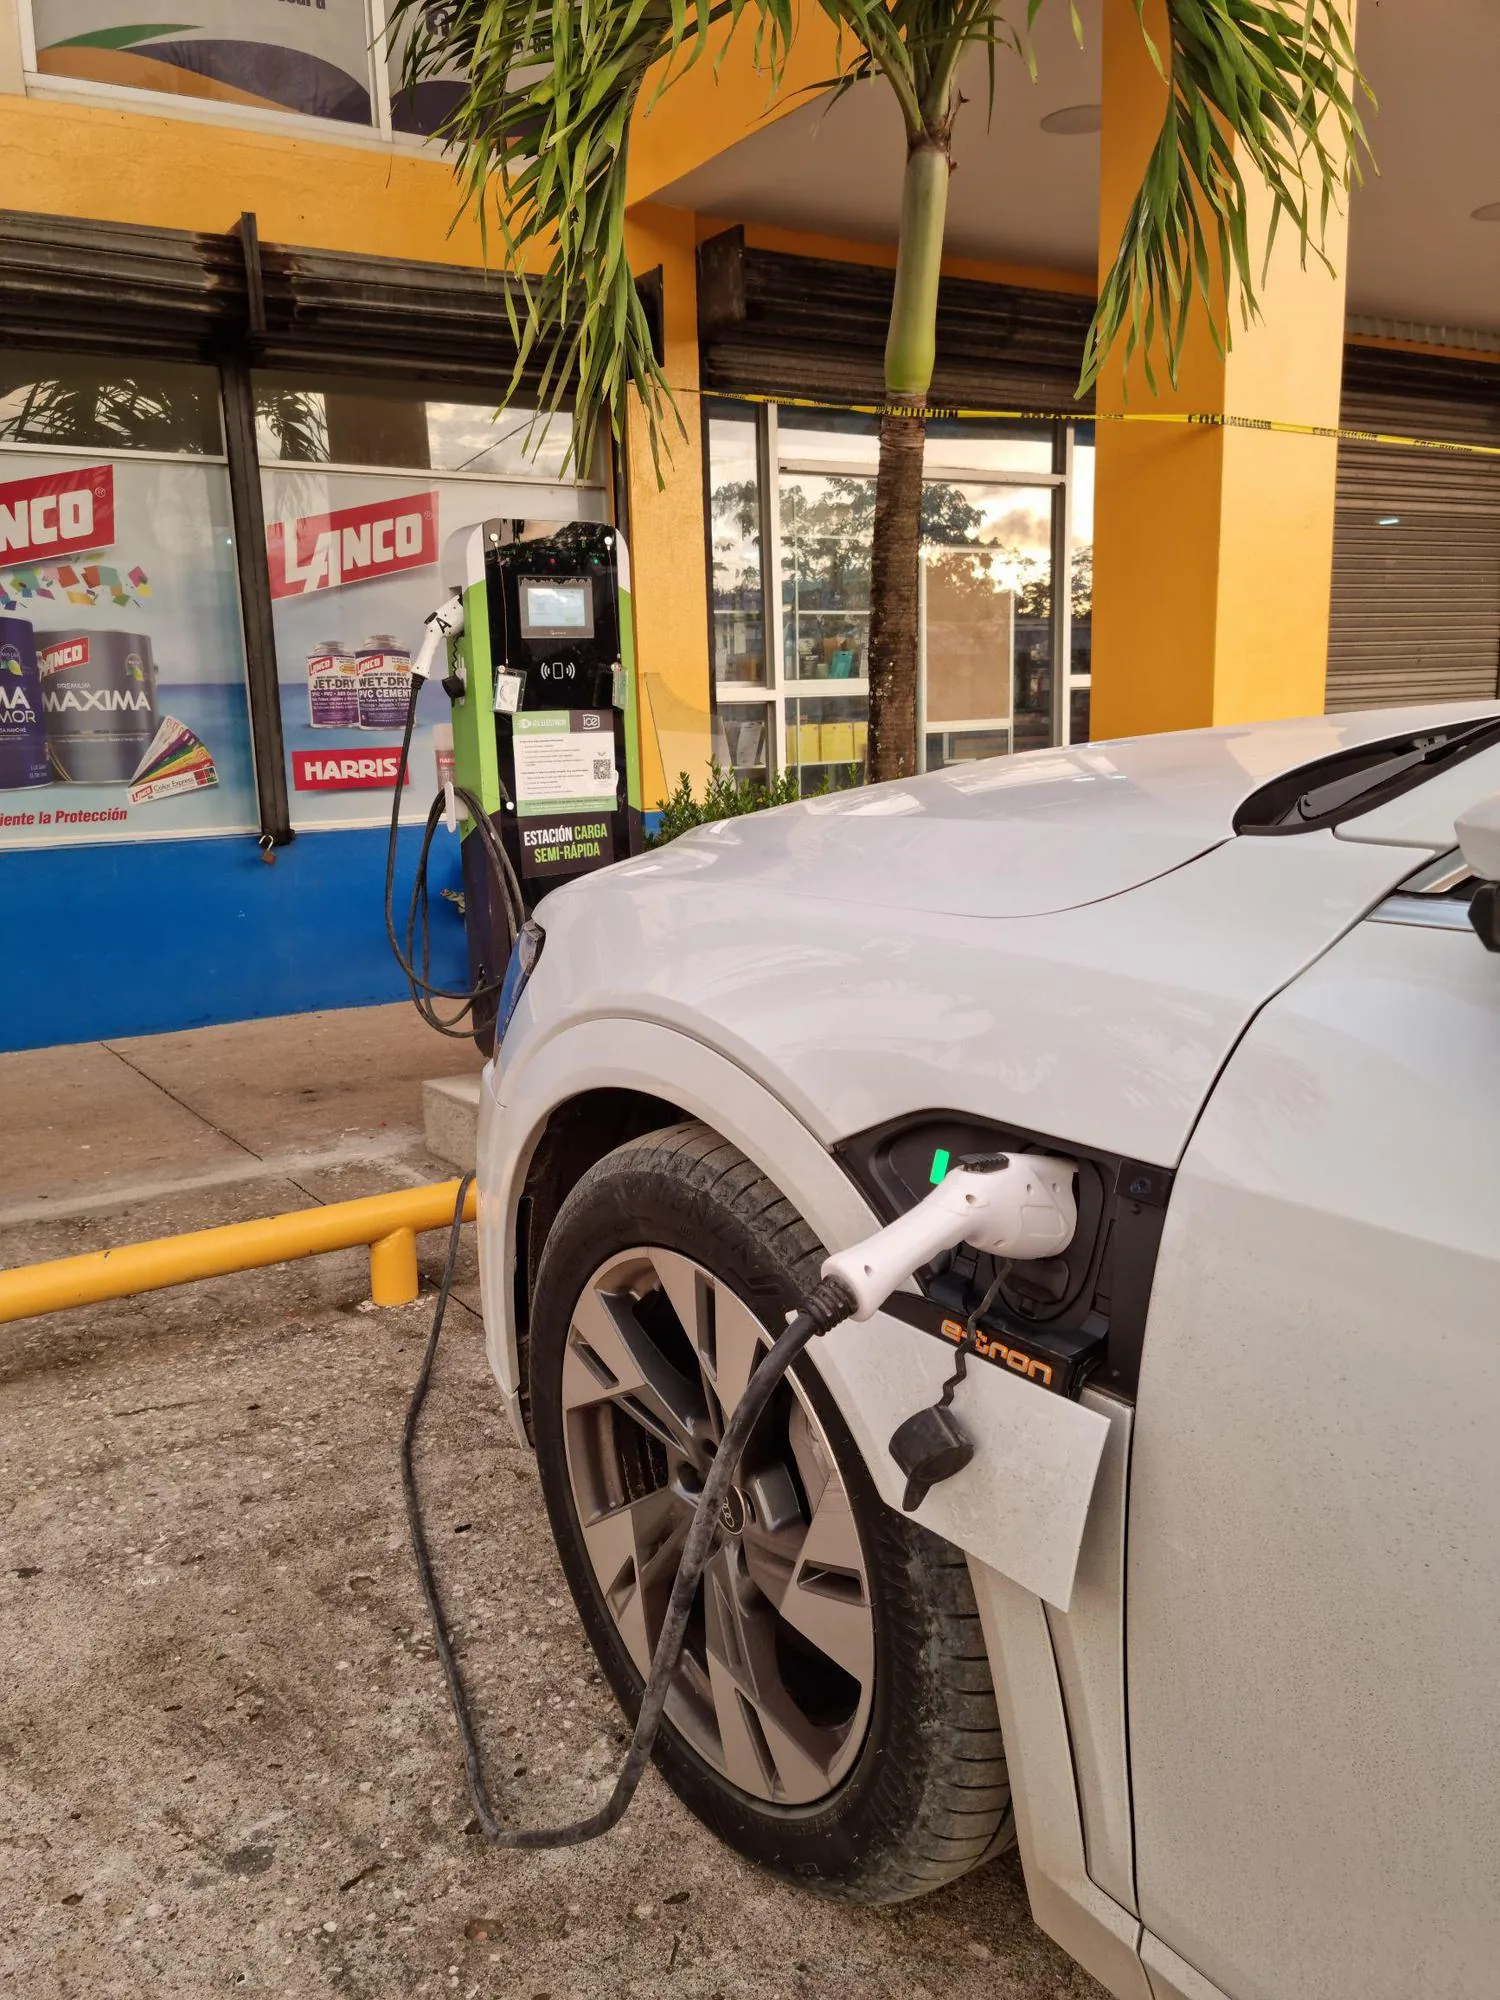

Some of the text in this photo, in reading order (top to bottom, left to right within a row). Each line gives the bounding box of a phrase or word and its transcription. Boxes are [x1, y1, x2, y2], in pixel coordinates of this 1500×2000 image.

[283, 513, 423, 594] LANCO
[436, 616, 452, 634] A
[313, 679, 355, 689] JET-DRY
[358, 676, 410, 688] WET-DRY
[42, 689, 152, 712] MAXIMA
[359, 689, 374, 699] PVC
[303, 758, 398, 781] HARRIS
[153, 782, 171, 792] Color
[39, 811, 52, 824] la
[55, 807, 128, 823] Protección
[523, 823, 608, 847] ESTACIÓN CARGA
[534, 842, 601, 863] SEMI-RÁPIDA
[941, 1319, 1052, 1385] e-tron
